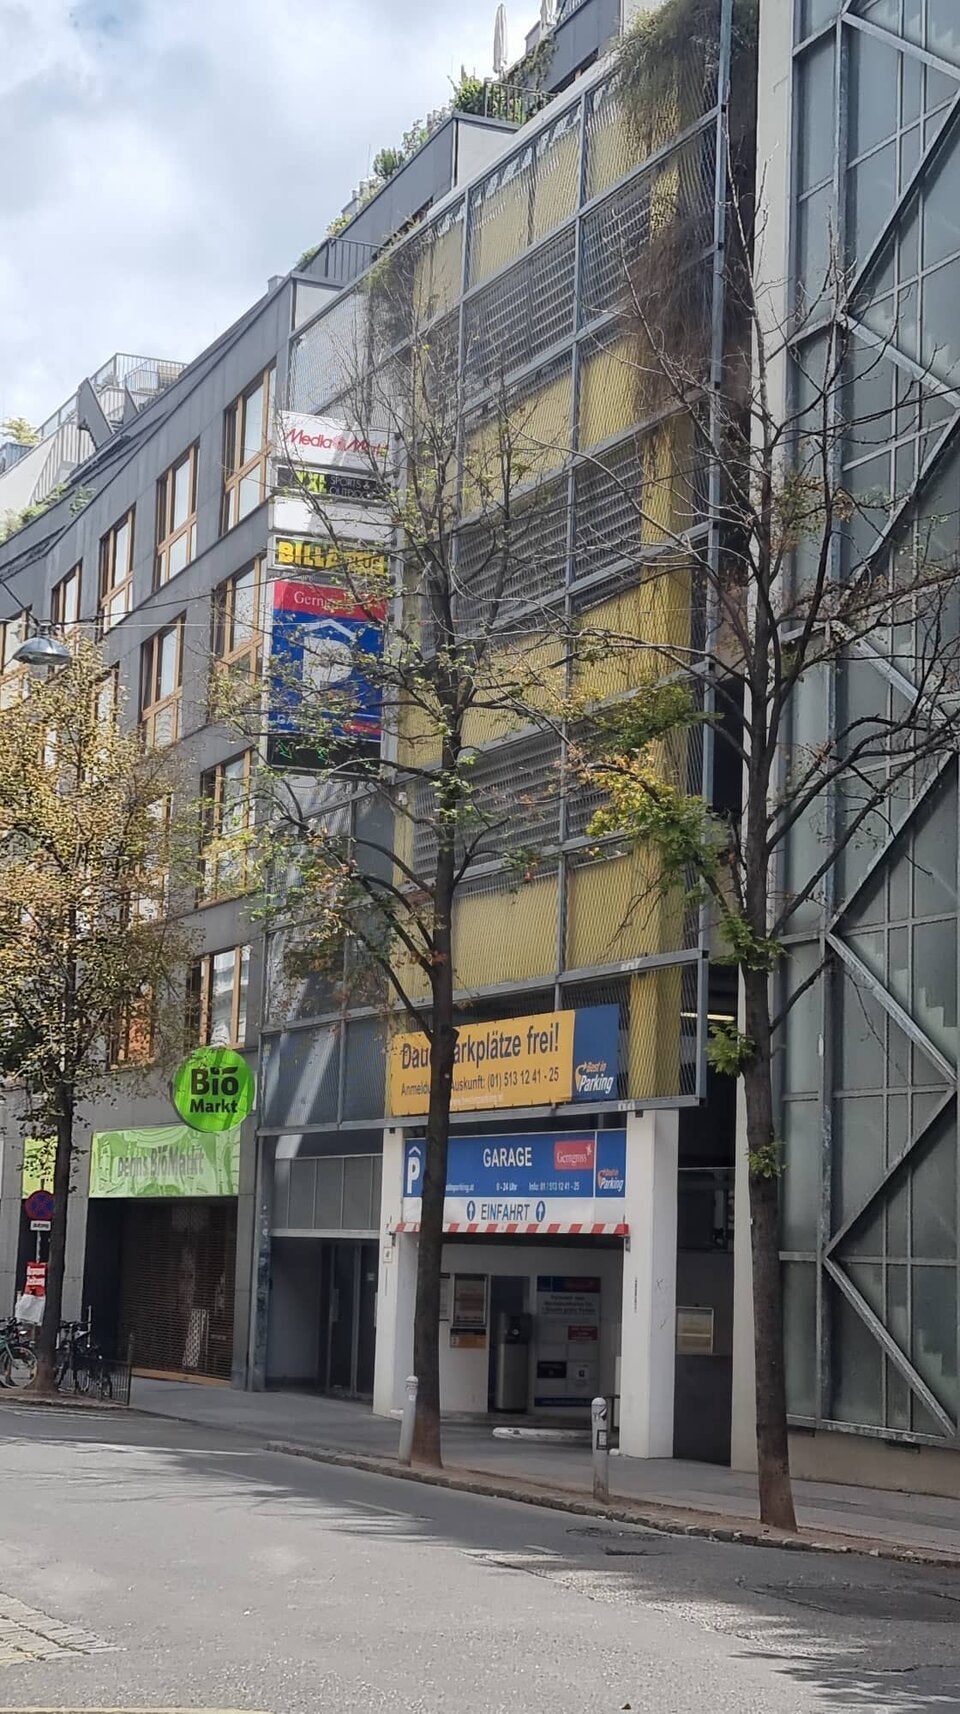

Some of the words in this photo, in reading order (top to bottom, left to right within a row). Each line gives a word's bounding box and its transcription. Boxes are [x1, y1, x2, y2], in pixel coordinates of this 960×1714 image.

[286, 428, 333, 449] Media
[330, 476, 362, 489] SPORTS
[278, 541, 341, 570] BILLA
[527, 1022, 559, 1056] frei!
[504, 1070, 518, 1087] 513
[520, 1070, 531, 1085] 12
[532, 1069, 542, 1084] 41
[549, 1067, 559, 1083] 25
[579, 1074, 614, 1095] Parking
[189, 1099, 238, 1114] Markt
[483, 1147, 532, 1168] GARAGE
[407, 1157, 420, 1194] P
[600, 1177, 623, 1192] Parking
[481, 1203, 530, 1221] EINFAHRT
